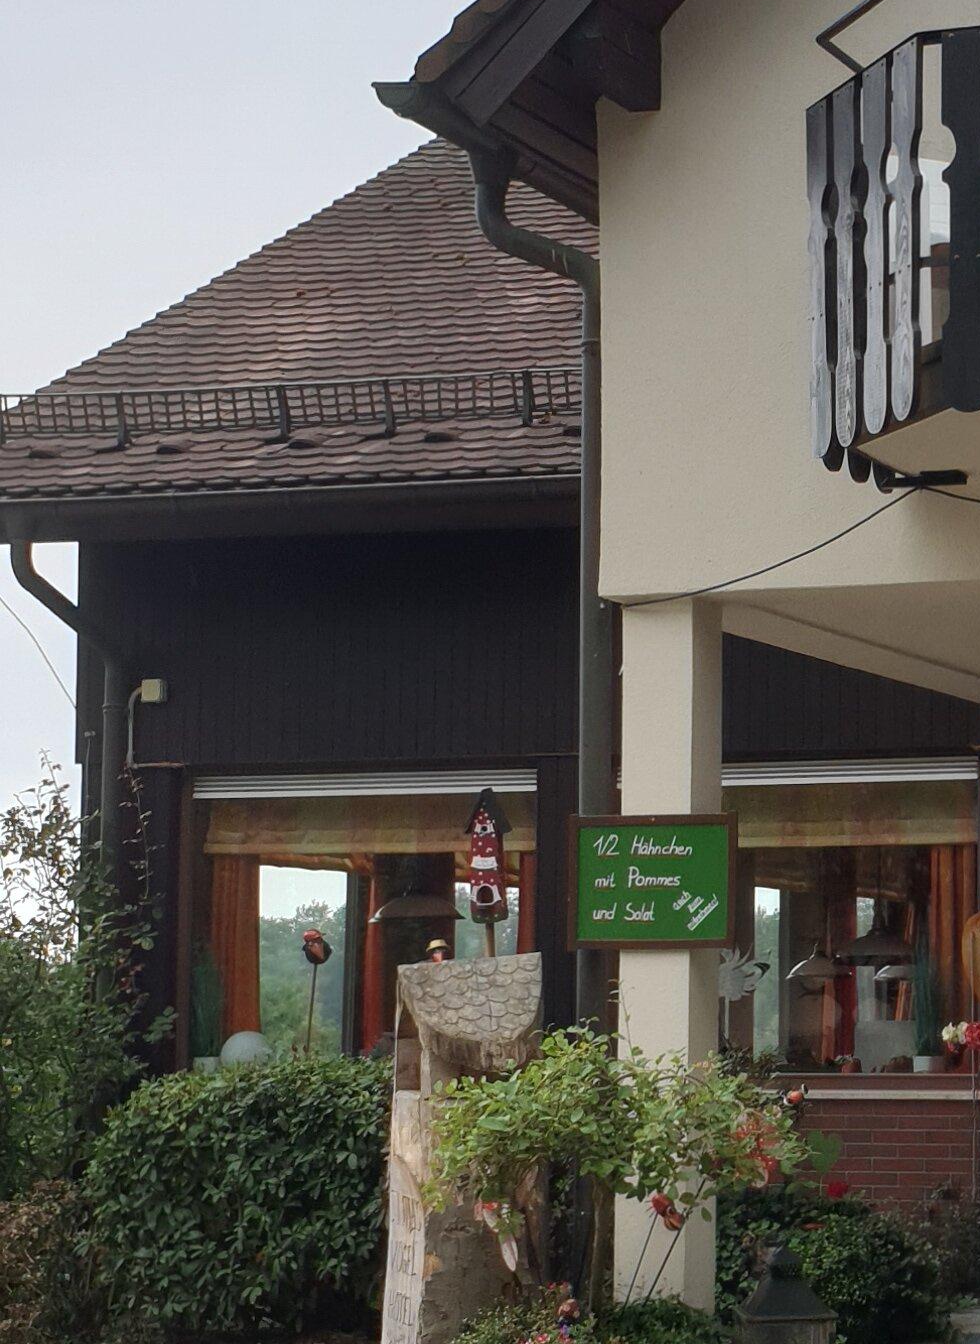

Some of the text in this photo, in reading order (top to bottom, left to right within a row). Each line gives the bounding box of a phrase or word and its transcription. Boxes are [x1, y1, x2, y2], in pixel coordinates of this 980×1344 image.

[593, 834, 693, 856] 1/2 Hähnchen
[594, 866, 681, 888] mit Pommes
[592, 901, 655, 921] und Salat
